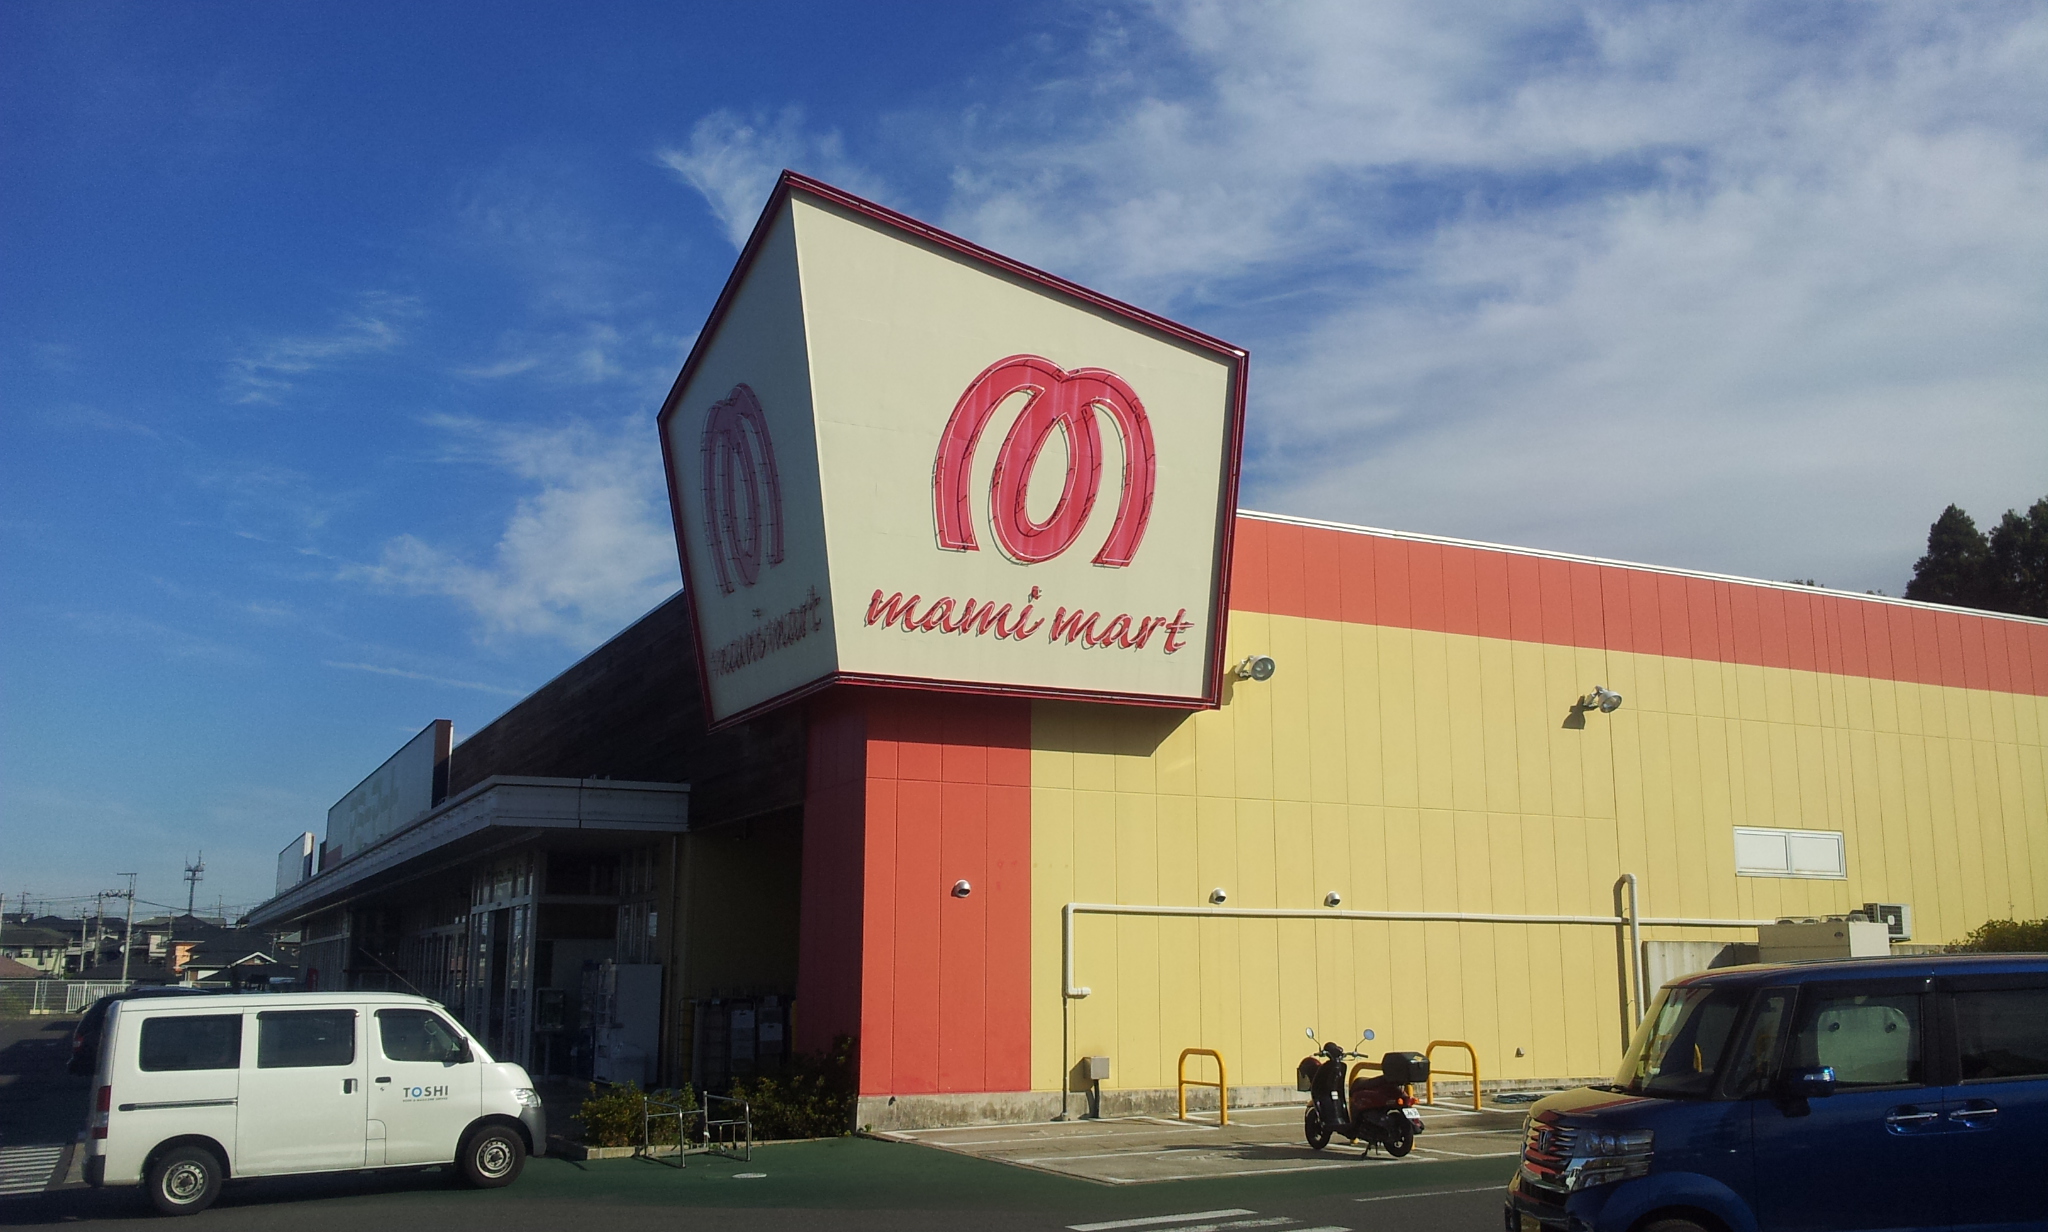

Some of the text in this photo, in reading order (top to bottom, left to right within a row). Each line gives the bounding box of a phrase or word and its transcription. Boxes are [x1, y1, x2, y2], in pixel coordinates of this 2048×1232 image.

[864, 585, 1194, 655] mami mart
[402, 1085, 449, 1098] TOSHI
